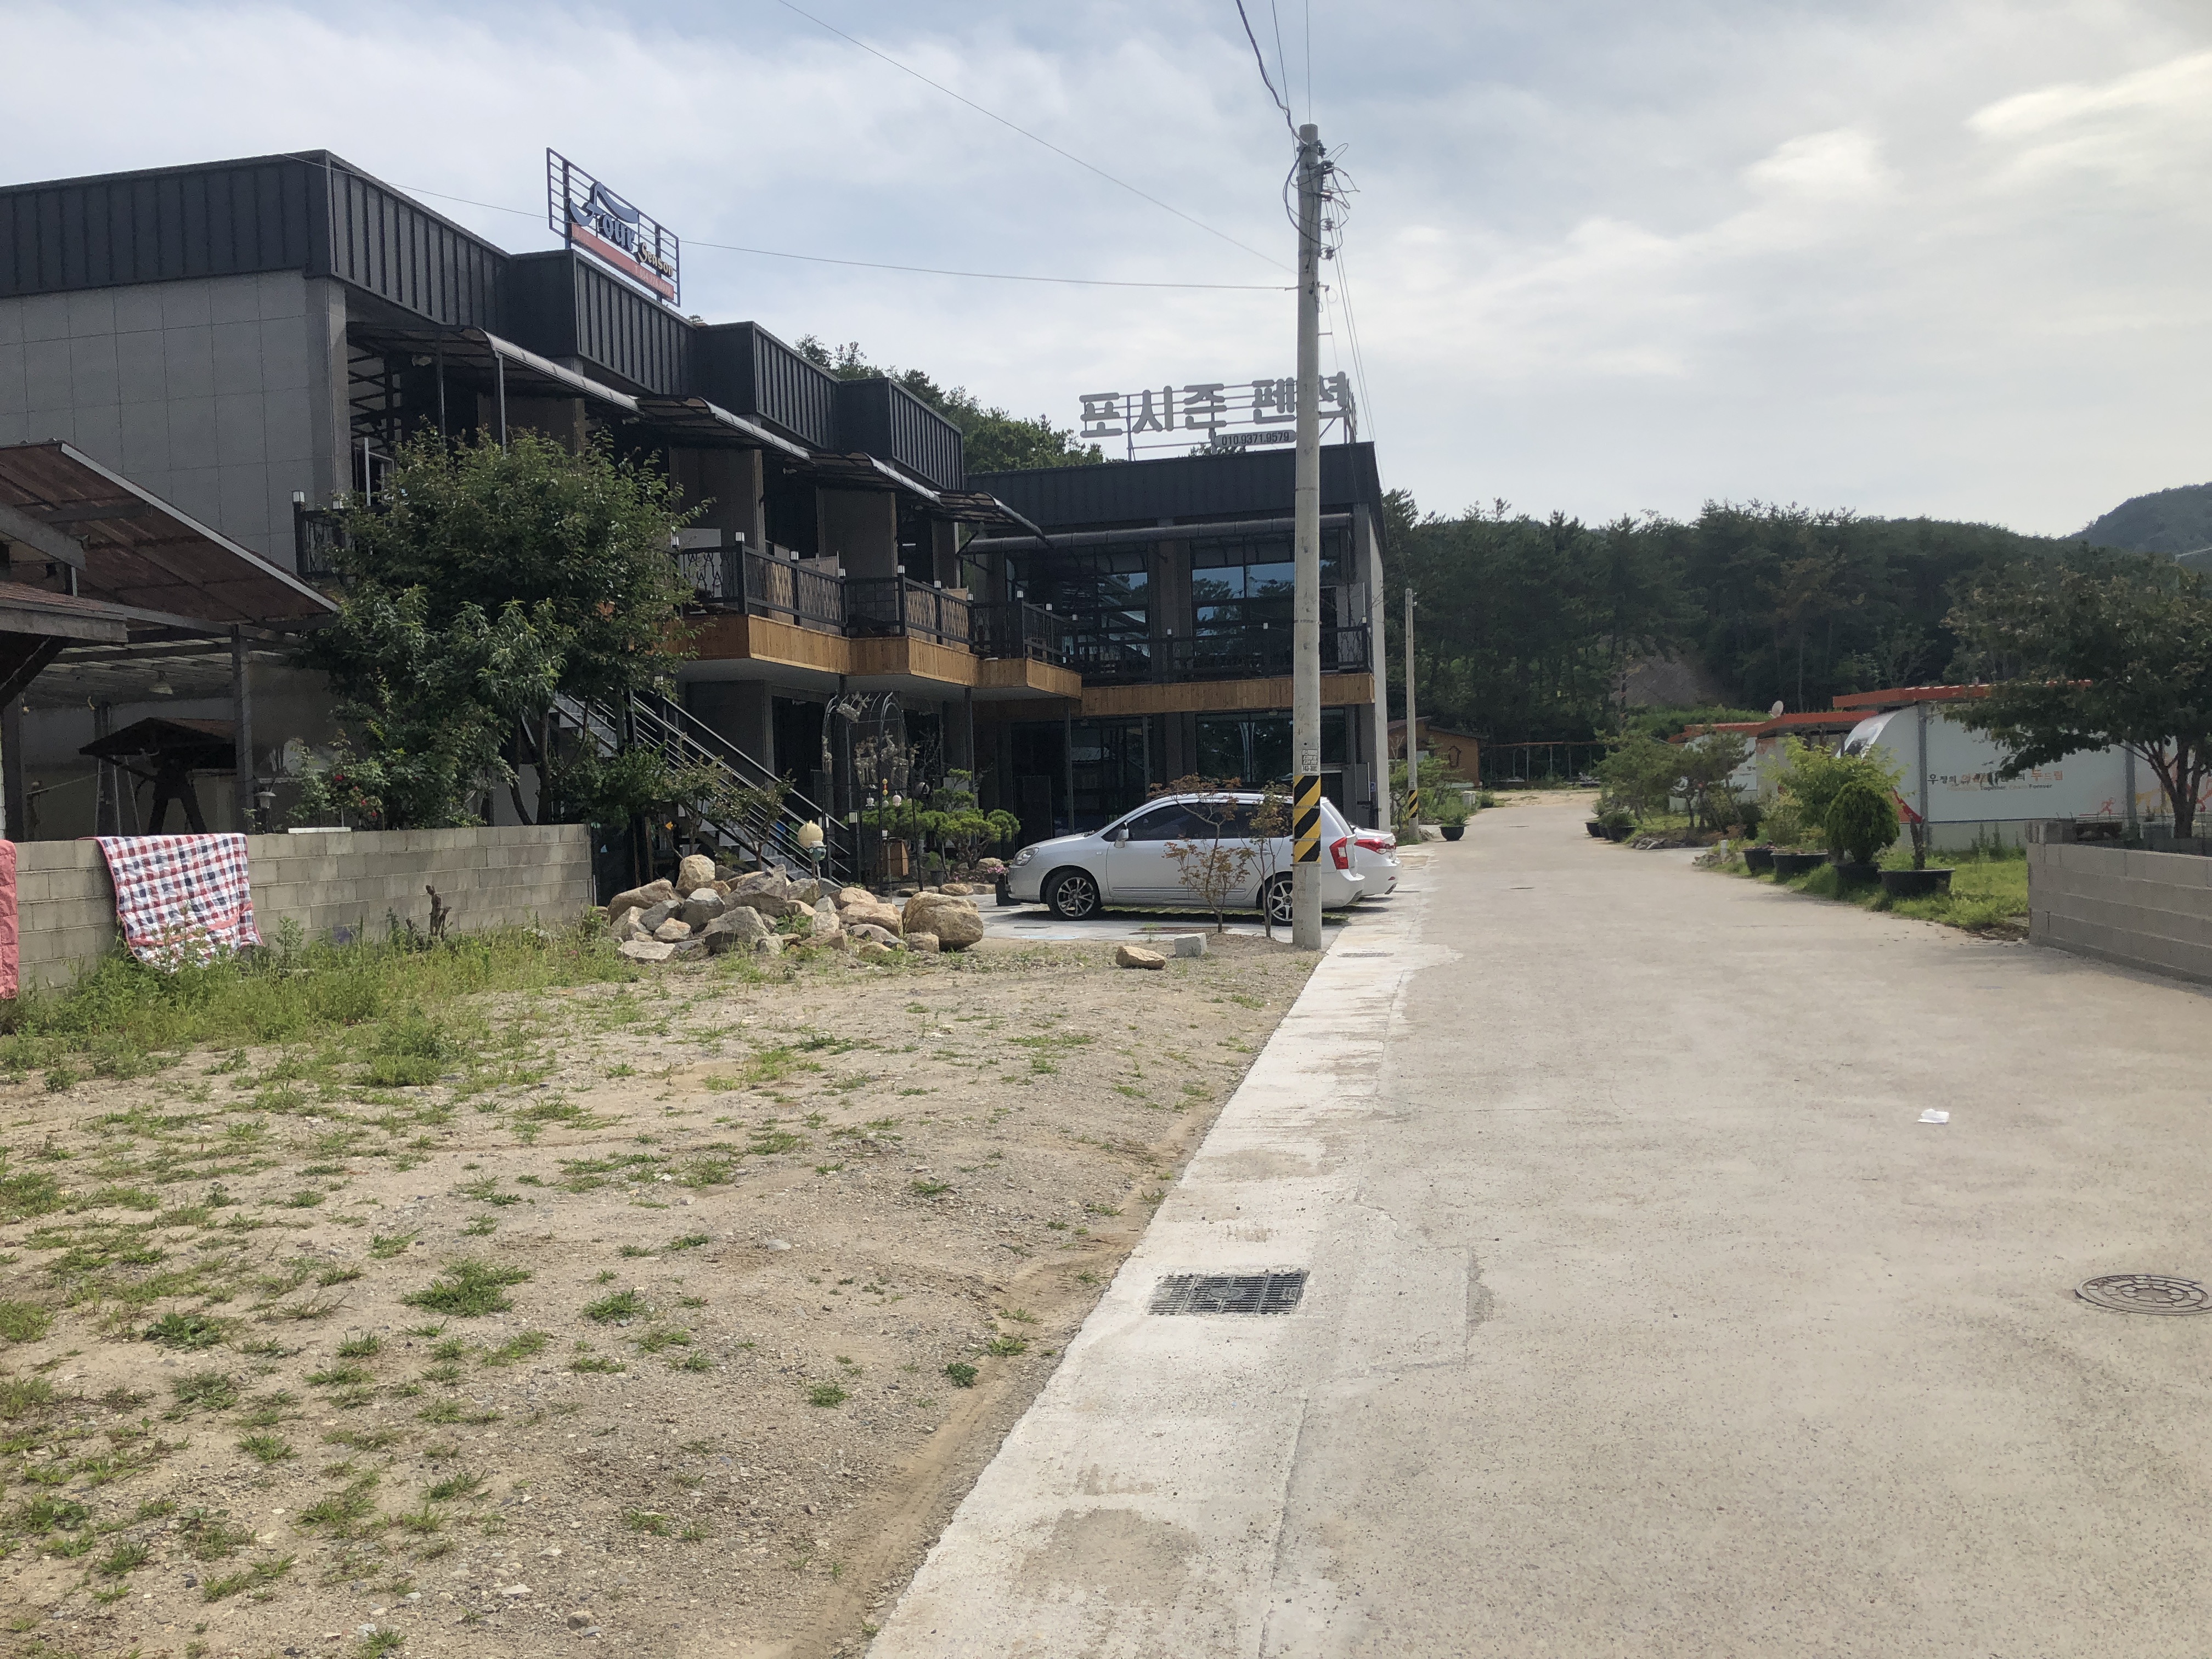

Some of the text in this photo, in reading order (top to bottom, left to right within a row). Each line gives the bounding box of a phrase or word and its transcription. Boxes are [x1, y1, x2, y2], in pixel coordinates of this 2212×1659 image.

[569, 182, 639, 252] Four
[638, 242, 674, 277] Season
[1221, 432, 1289, 445] 010.9371.9579
[1927, 774, 1956, 785] 우정의
